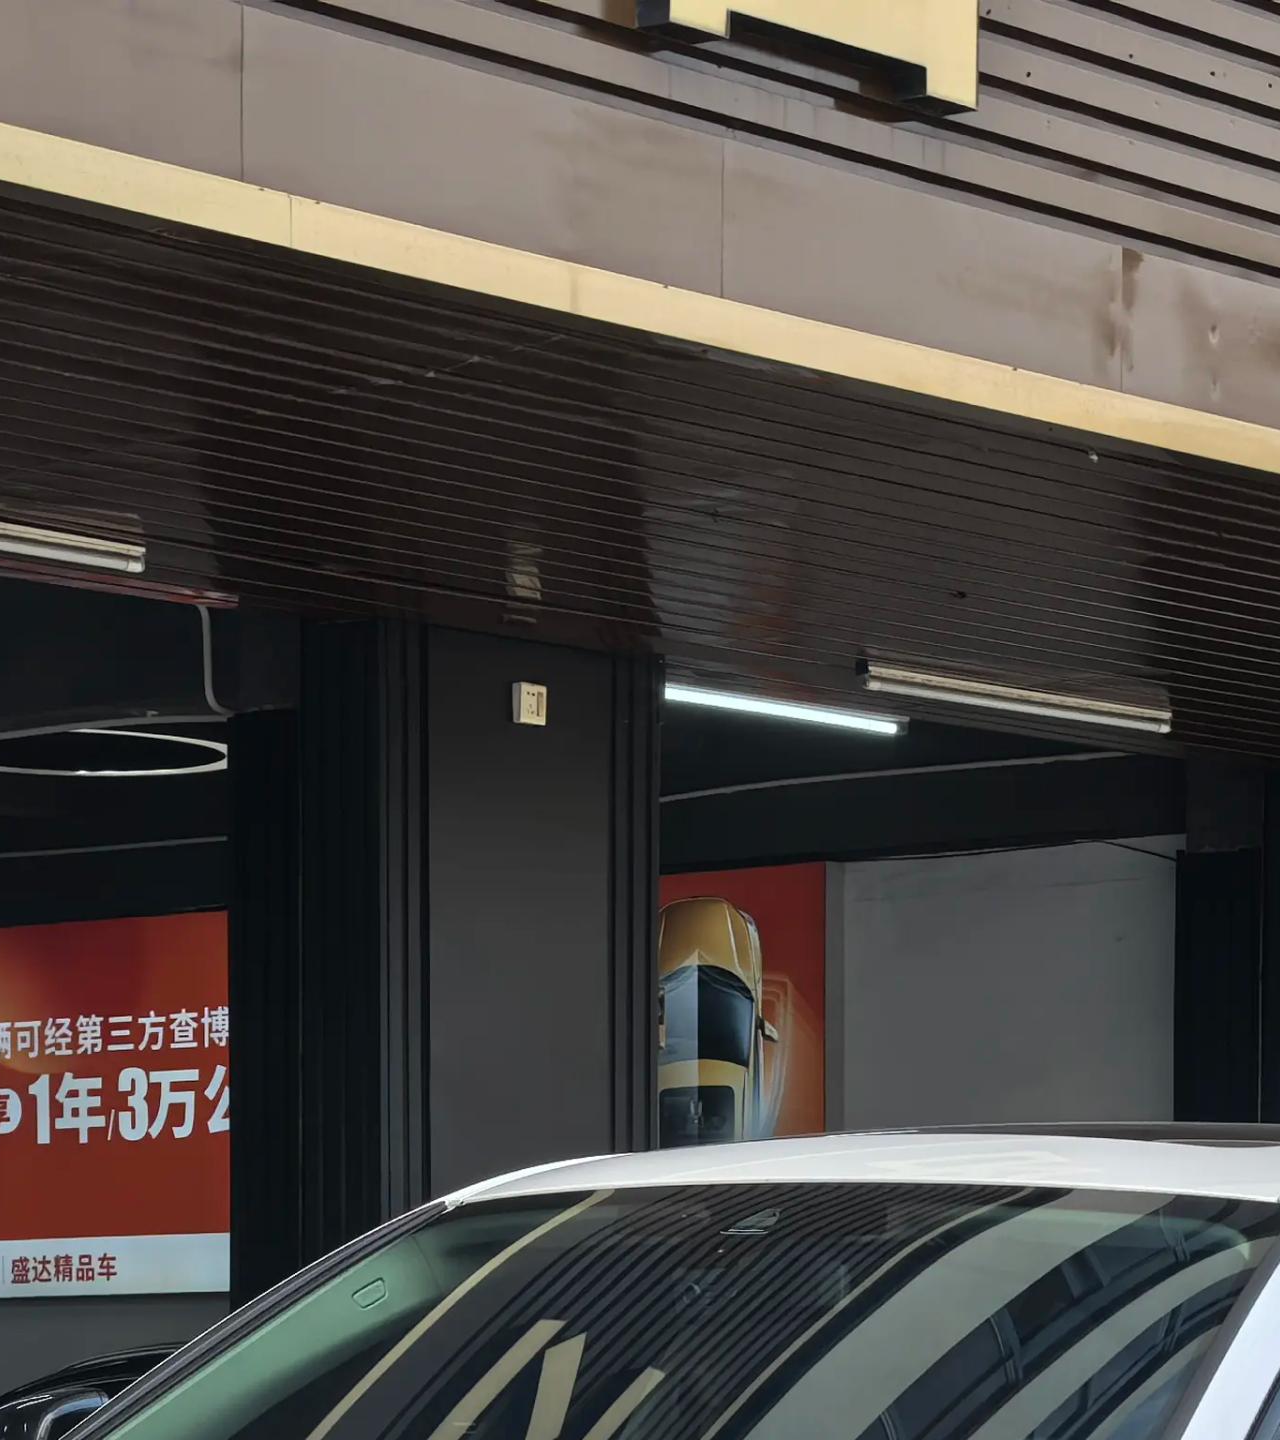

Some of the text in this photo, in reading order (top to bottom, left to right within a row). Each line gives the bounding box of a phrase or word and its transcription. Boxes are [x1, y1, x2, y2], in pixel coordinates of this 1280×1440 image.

[10, 1252, 118, 1285] 盛达精品车
